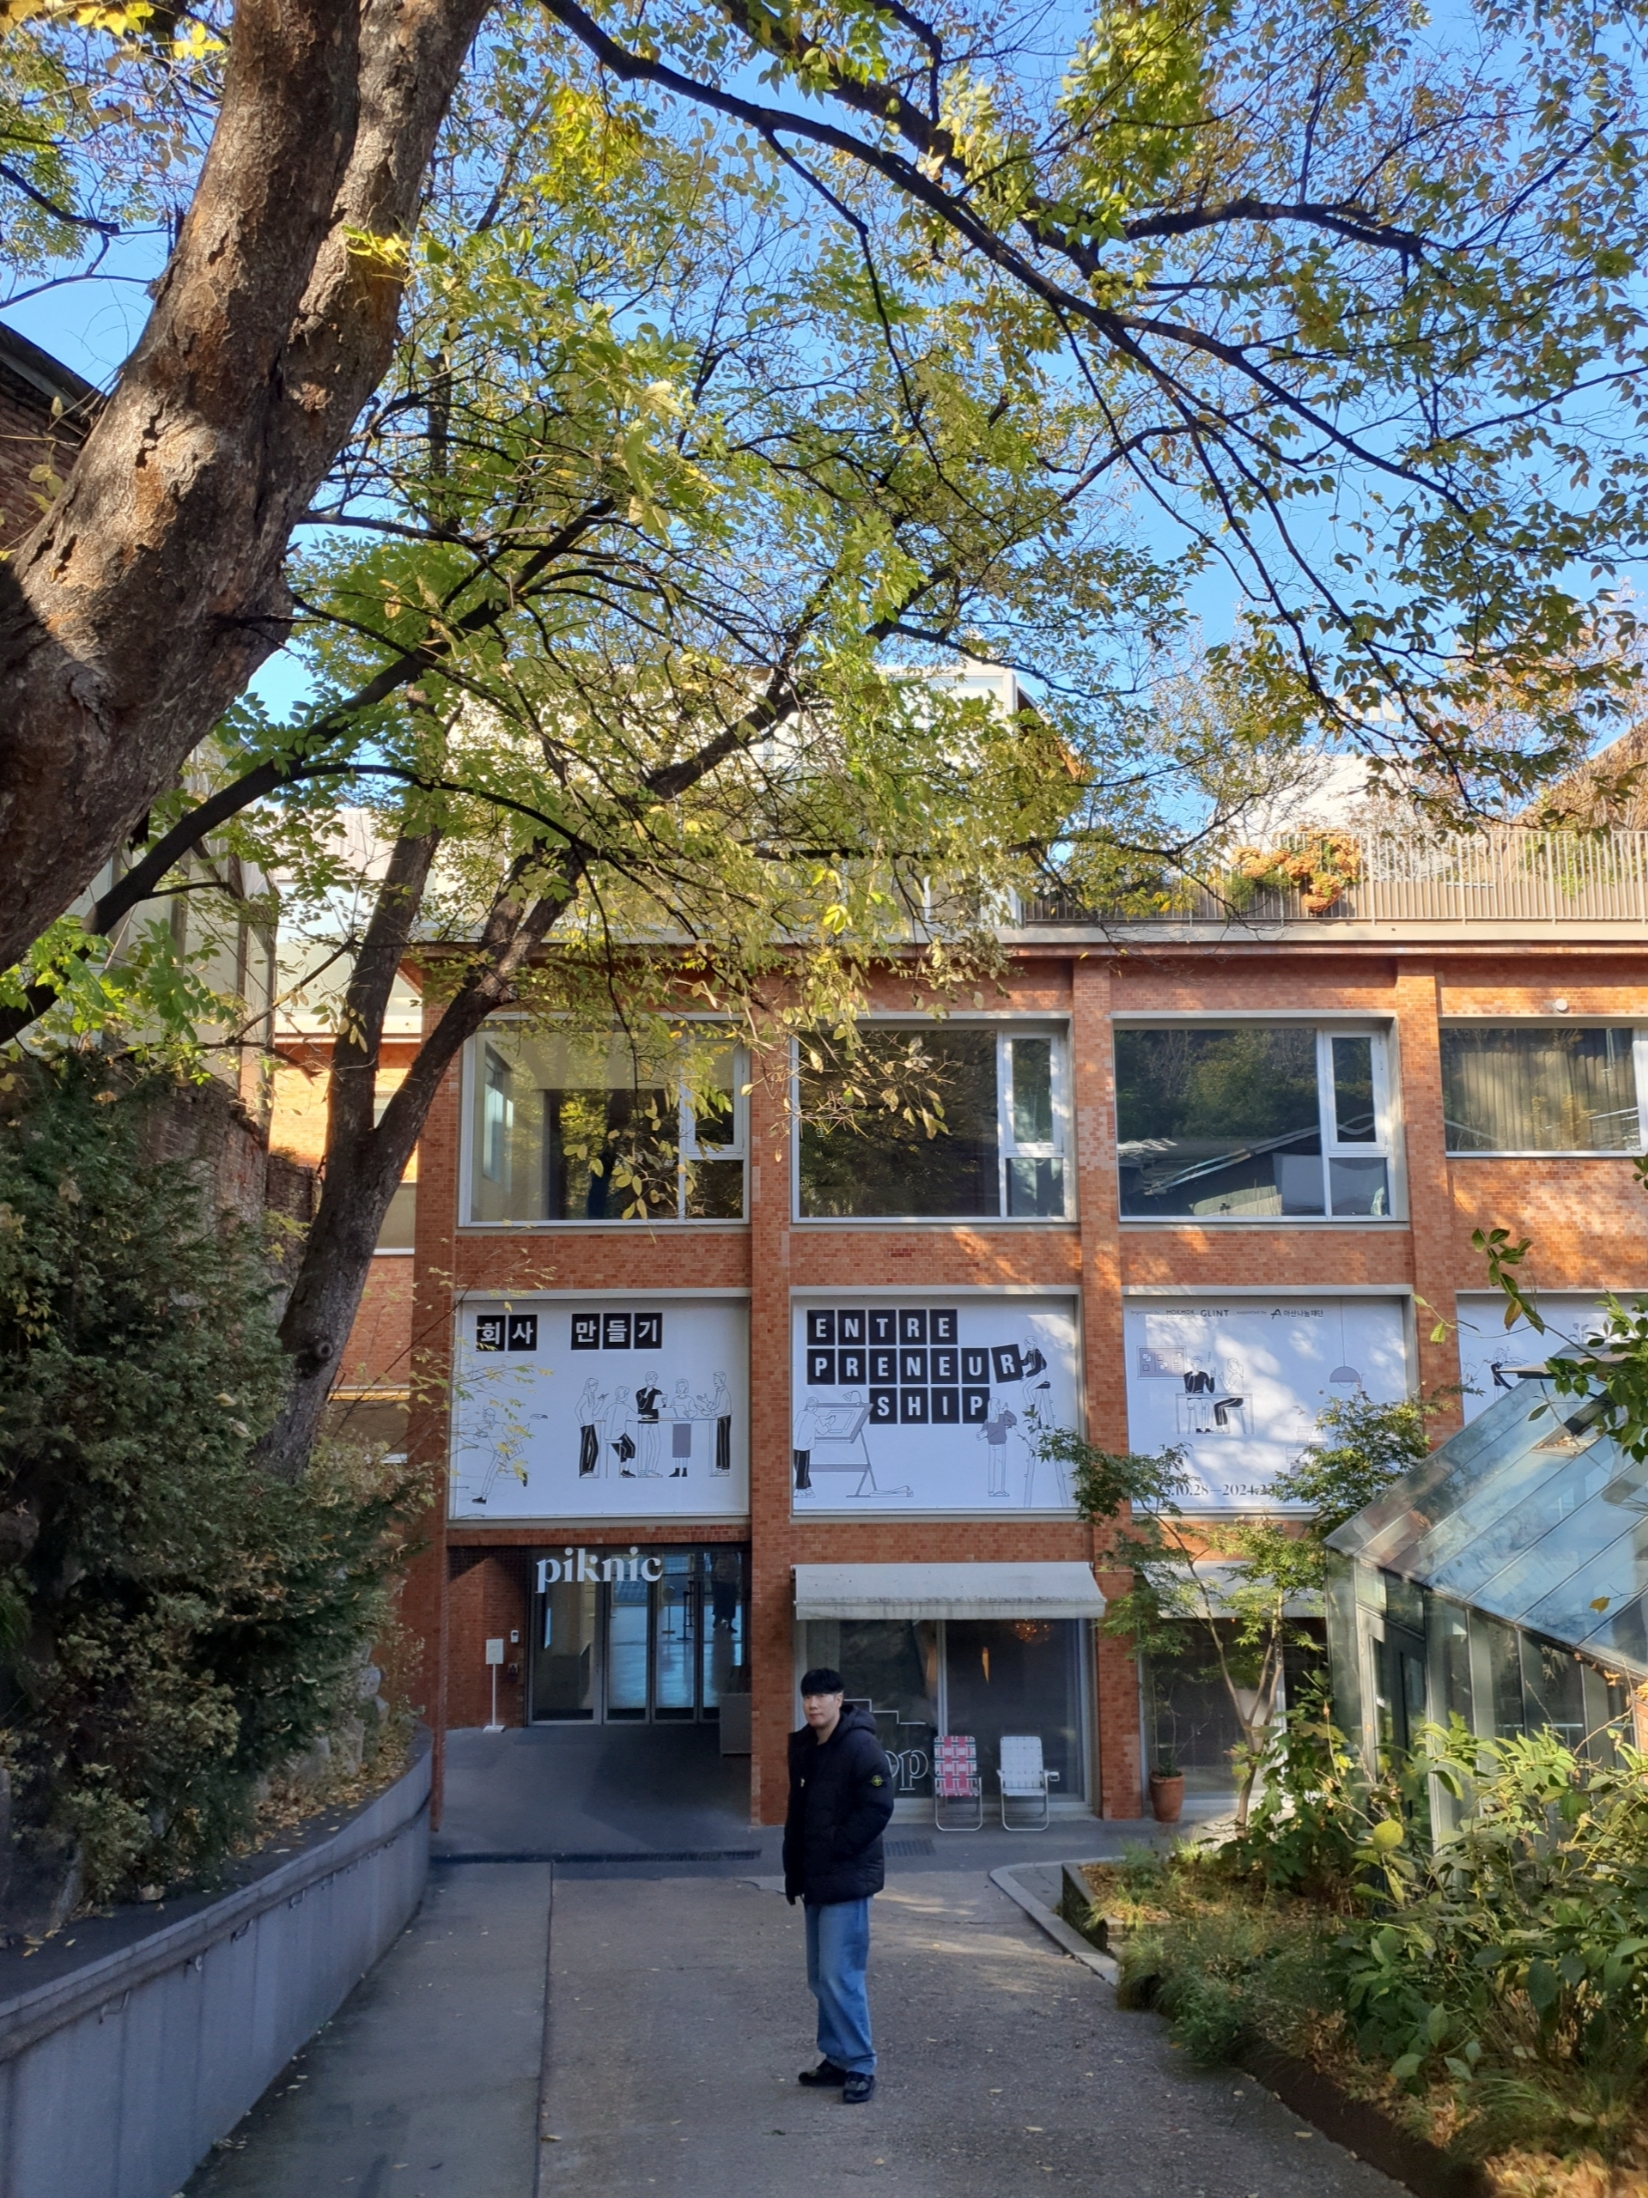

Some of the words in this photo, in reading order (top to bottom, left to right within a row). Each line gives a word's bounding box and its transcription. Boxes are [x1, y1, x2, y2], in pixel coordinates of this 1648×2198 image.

[1200, 1309, 1230, 1318] GLINT
[1283, 1309, 1324, 1318] 아산나눔재단
[480, 1320, 534, 1345] 회사
[575, 1319, 658, 1343] 만들기
[815, 1317, 951, 1338] ENTRE
[815, 1354, 1016, 1377] PRENEUR
[877, 1395, 984, 1416] SHIP
[535, 1546, 663, 1594] piknic
